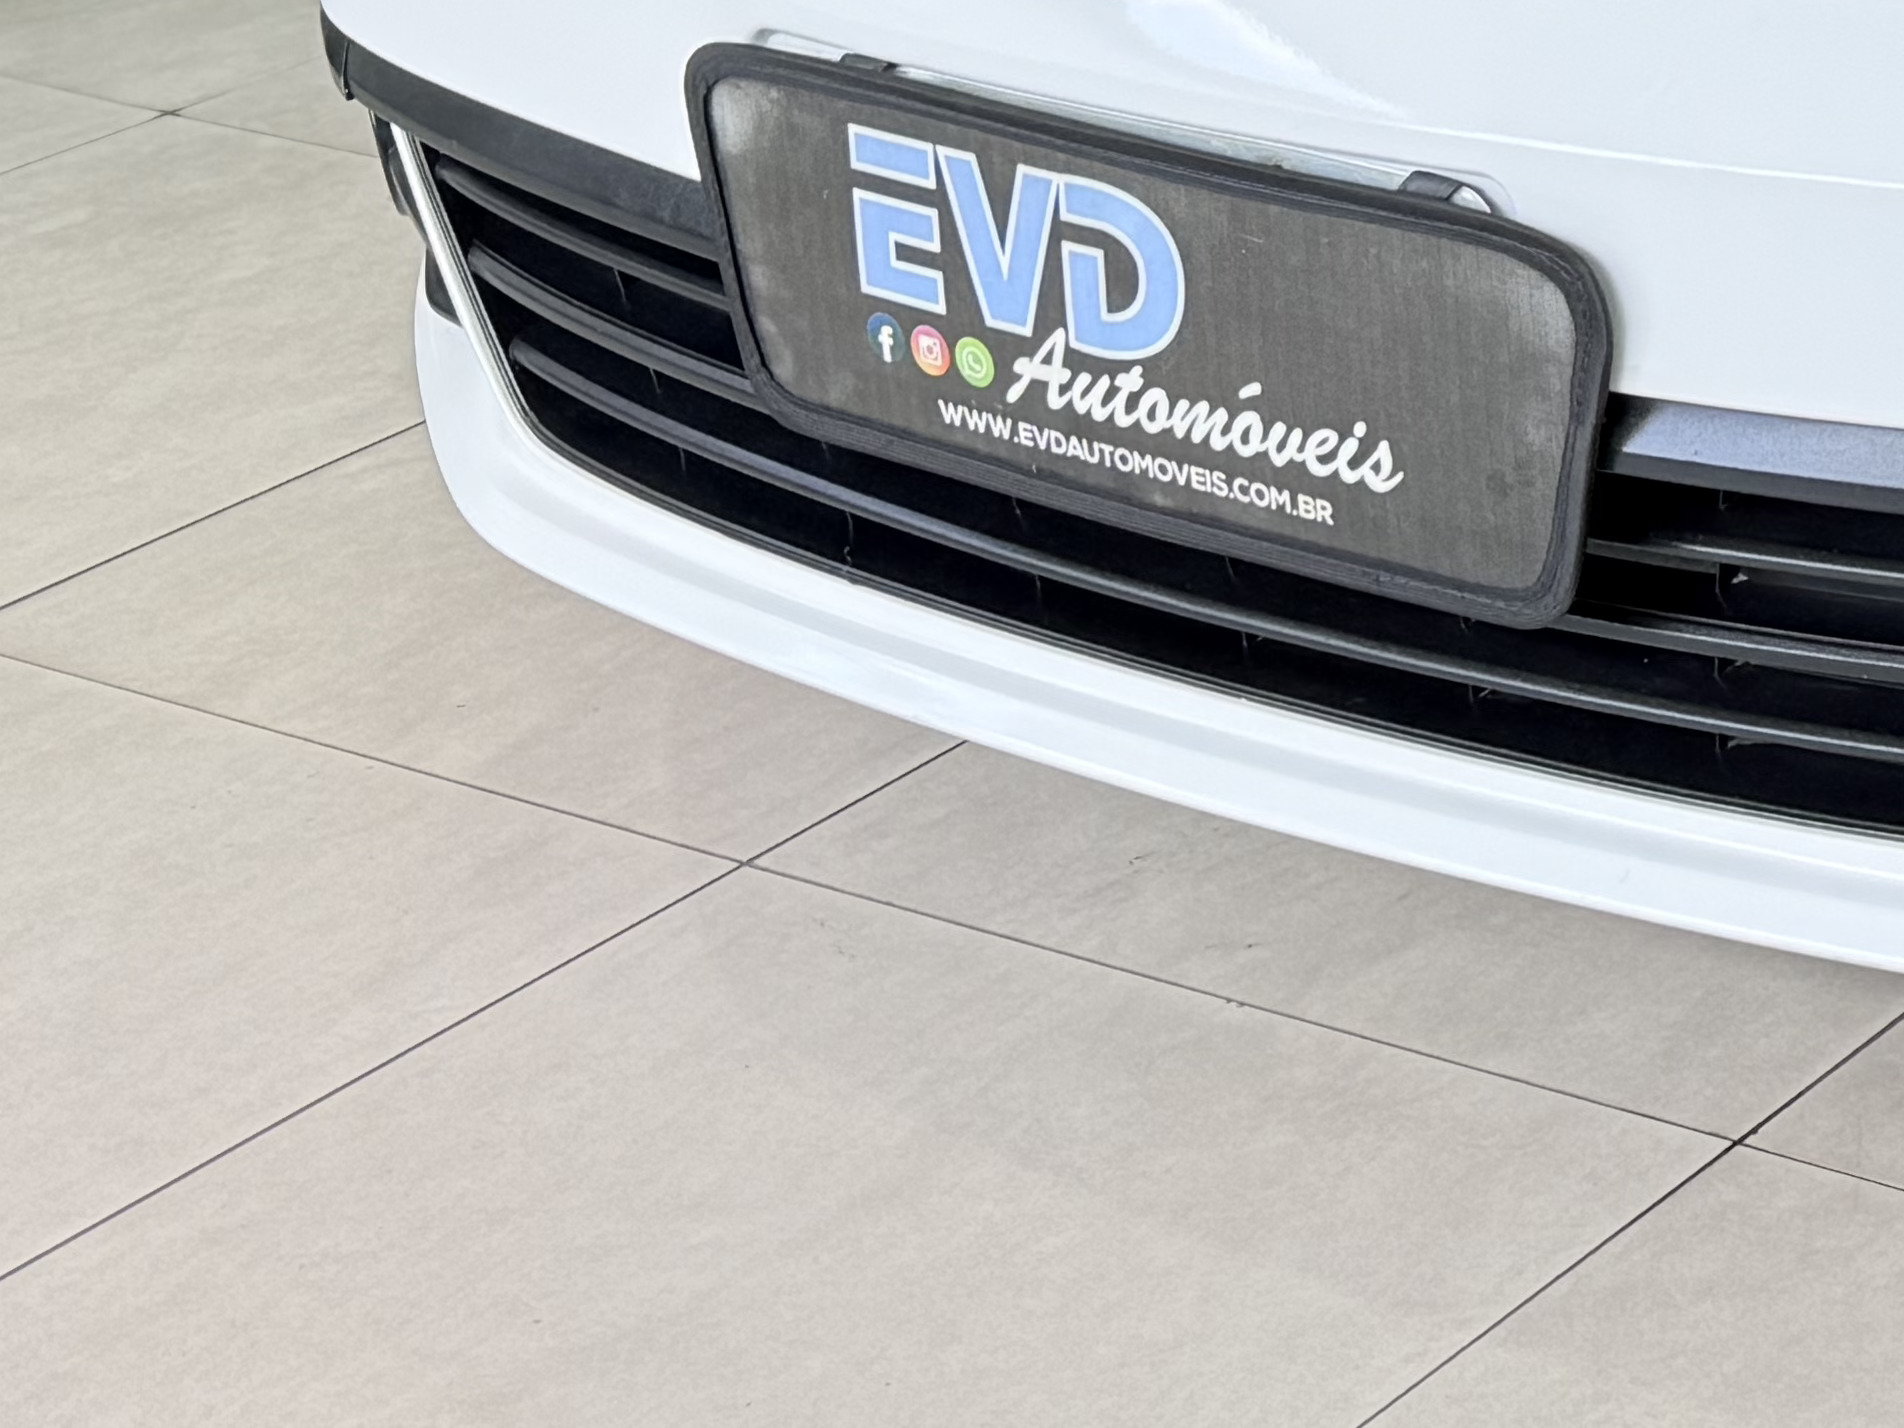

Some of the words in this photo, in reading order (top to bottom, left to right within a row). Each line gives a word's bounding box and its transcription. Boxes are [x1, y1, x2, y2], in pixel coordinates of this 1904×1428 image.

[848, 123, 1185, 360] EVD
[938, 399, 1335, 526] WWW.EVDAUTOMOVEIS.COM.BR
[1006, 328, 1404, 494] Automóveis
